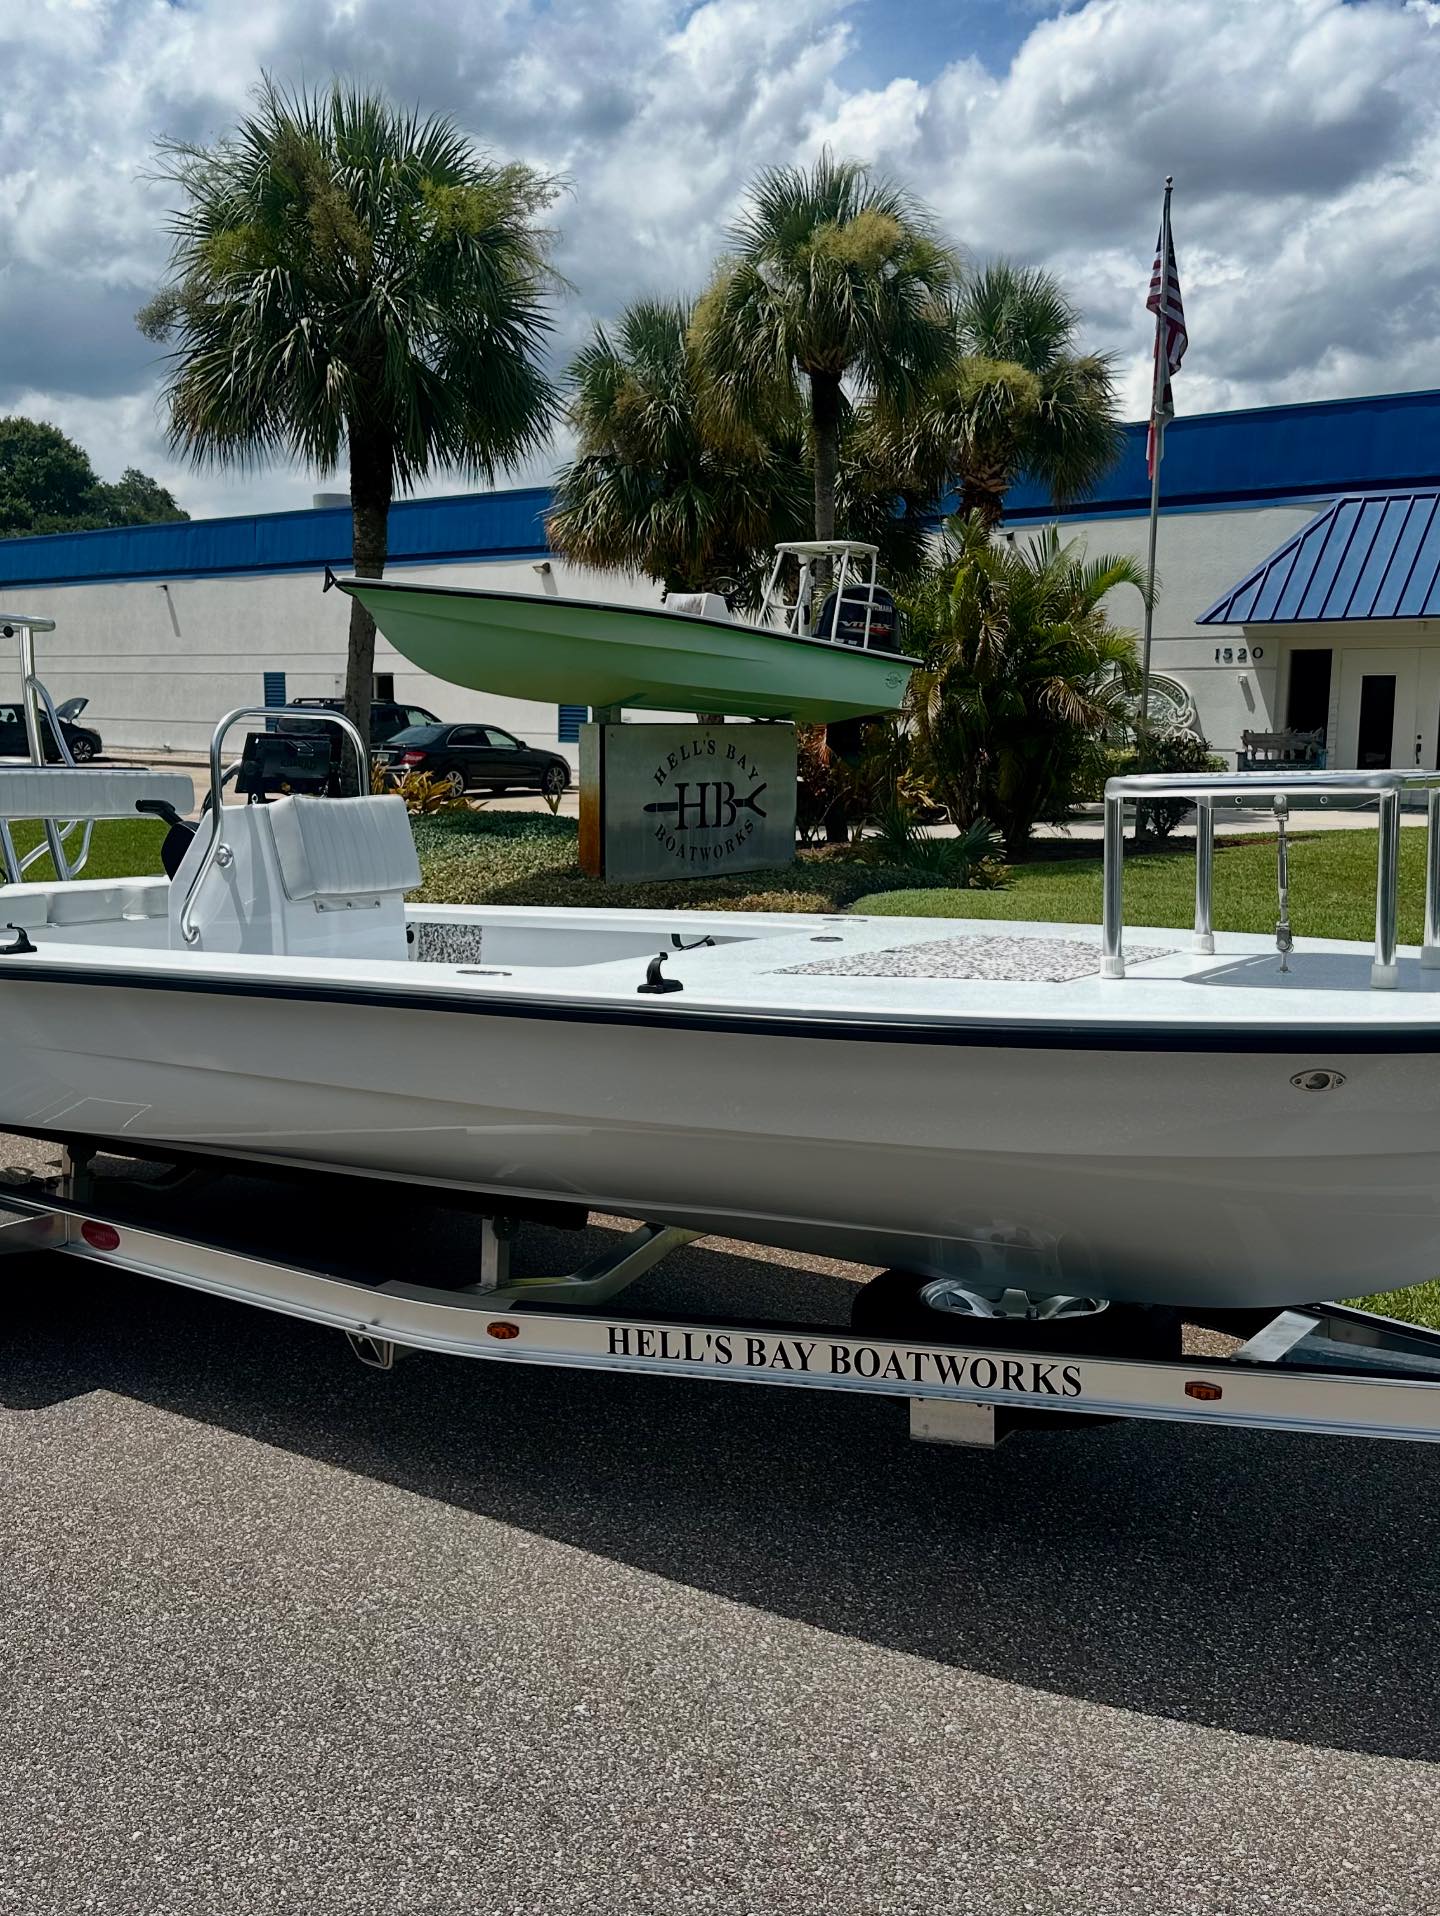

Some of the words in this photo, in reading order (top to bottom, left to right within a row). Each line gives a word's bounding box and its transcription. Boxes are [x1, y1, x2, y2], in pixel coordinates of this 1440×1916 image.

[1215, 647, 1264, 661] 1520
[652, 739, 717, 787] HELL'S
[726, 743, 759, 782] BAY
[674, 781, 737, 830] HB
[654, 818, 754, 863] BOATWORKS
[606, 1326, 733, 1365] HELL'S
[744, 1337, 817, 1371] BAY
[829, 1344, 1083, 1398] BOATWORKS
